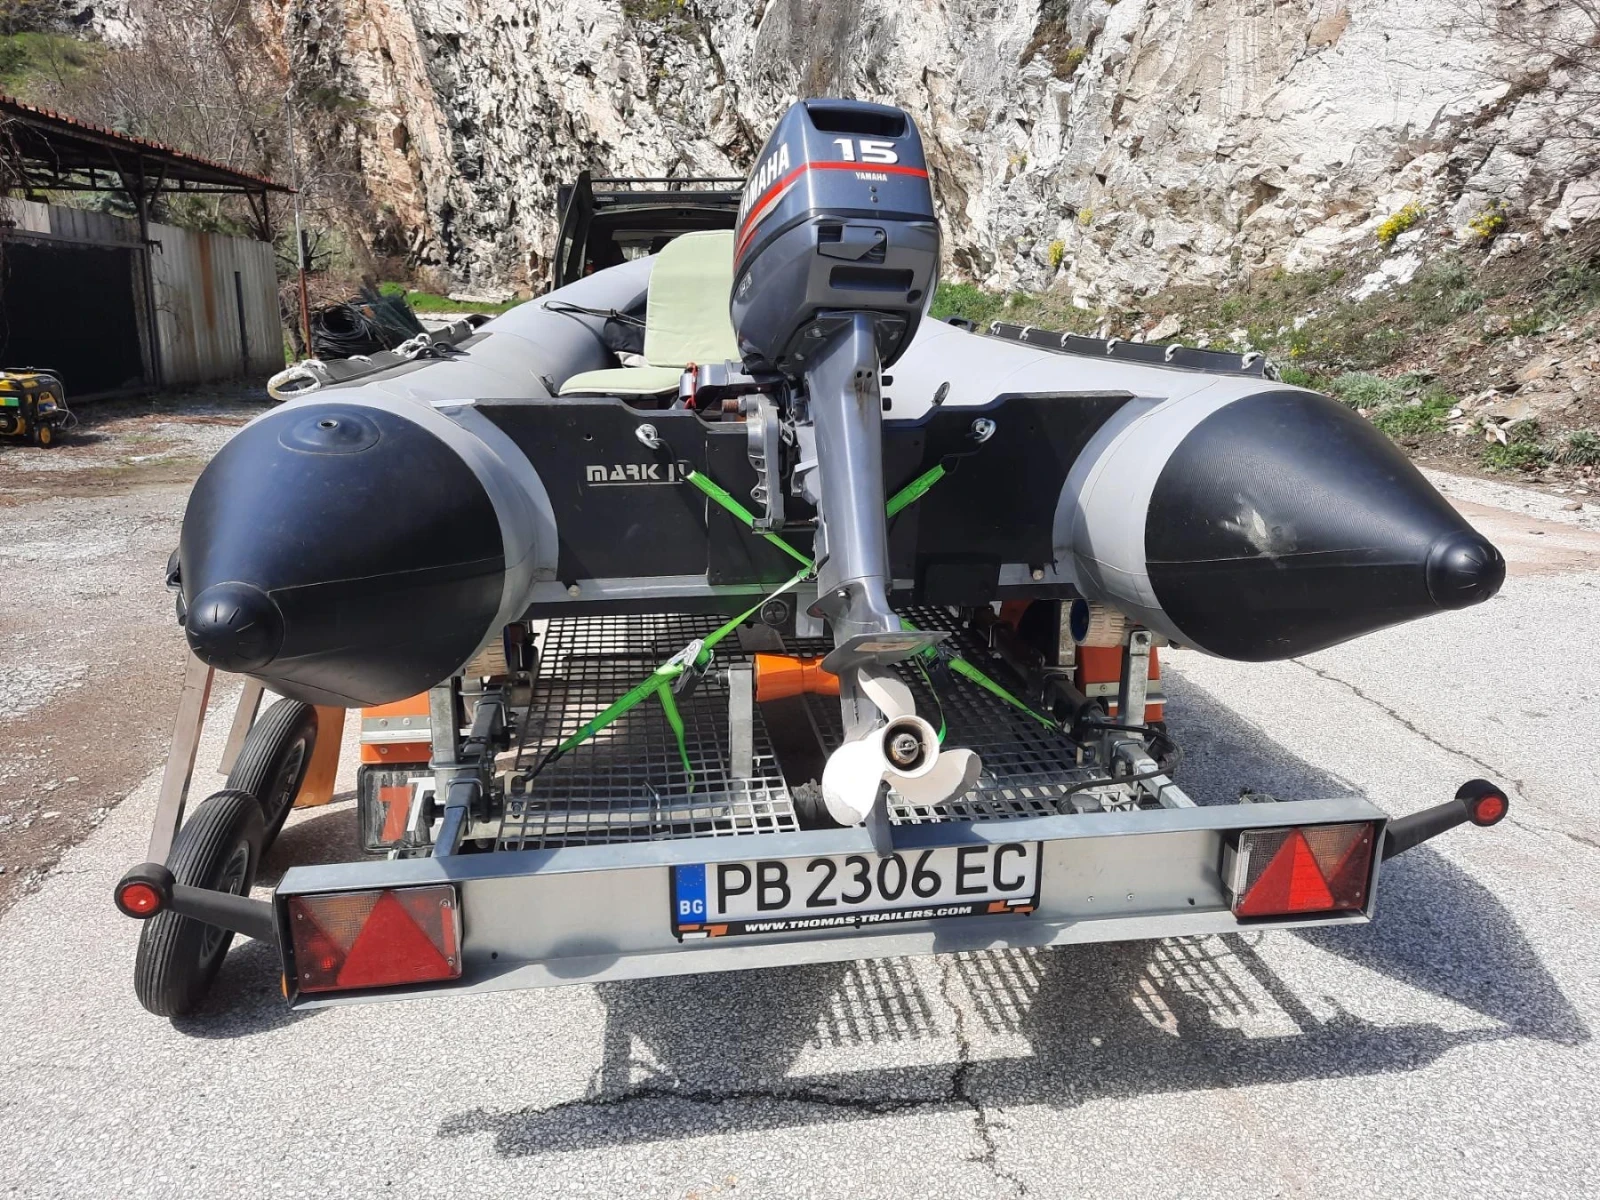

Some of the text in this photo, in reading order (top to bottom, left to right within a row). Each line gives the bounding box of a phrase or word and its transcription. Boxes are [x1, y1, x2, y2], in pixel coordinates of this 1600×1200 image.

[833, 138, 899, 165] 15
[855, 171, 888, 182] YAMAHA
[586, 463, 661, 481] MARK
[717, 843, 1027, 915] PB 2306 EC
[679, 899, 703, 916] BG
[745, 905, 972, 932] WWW.THOMAS-TRAILERS.COM
